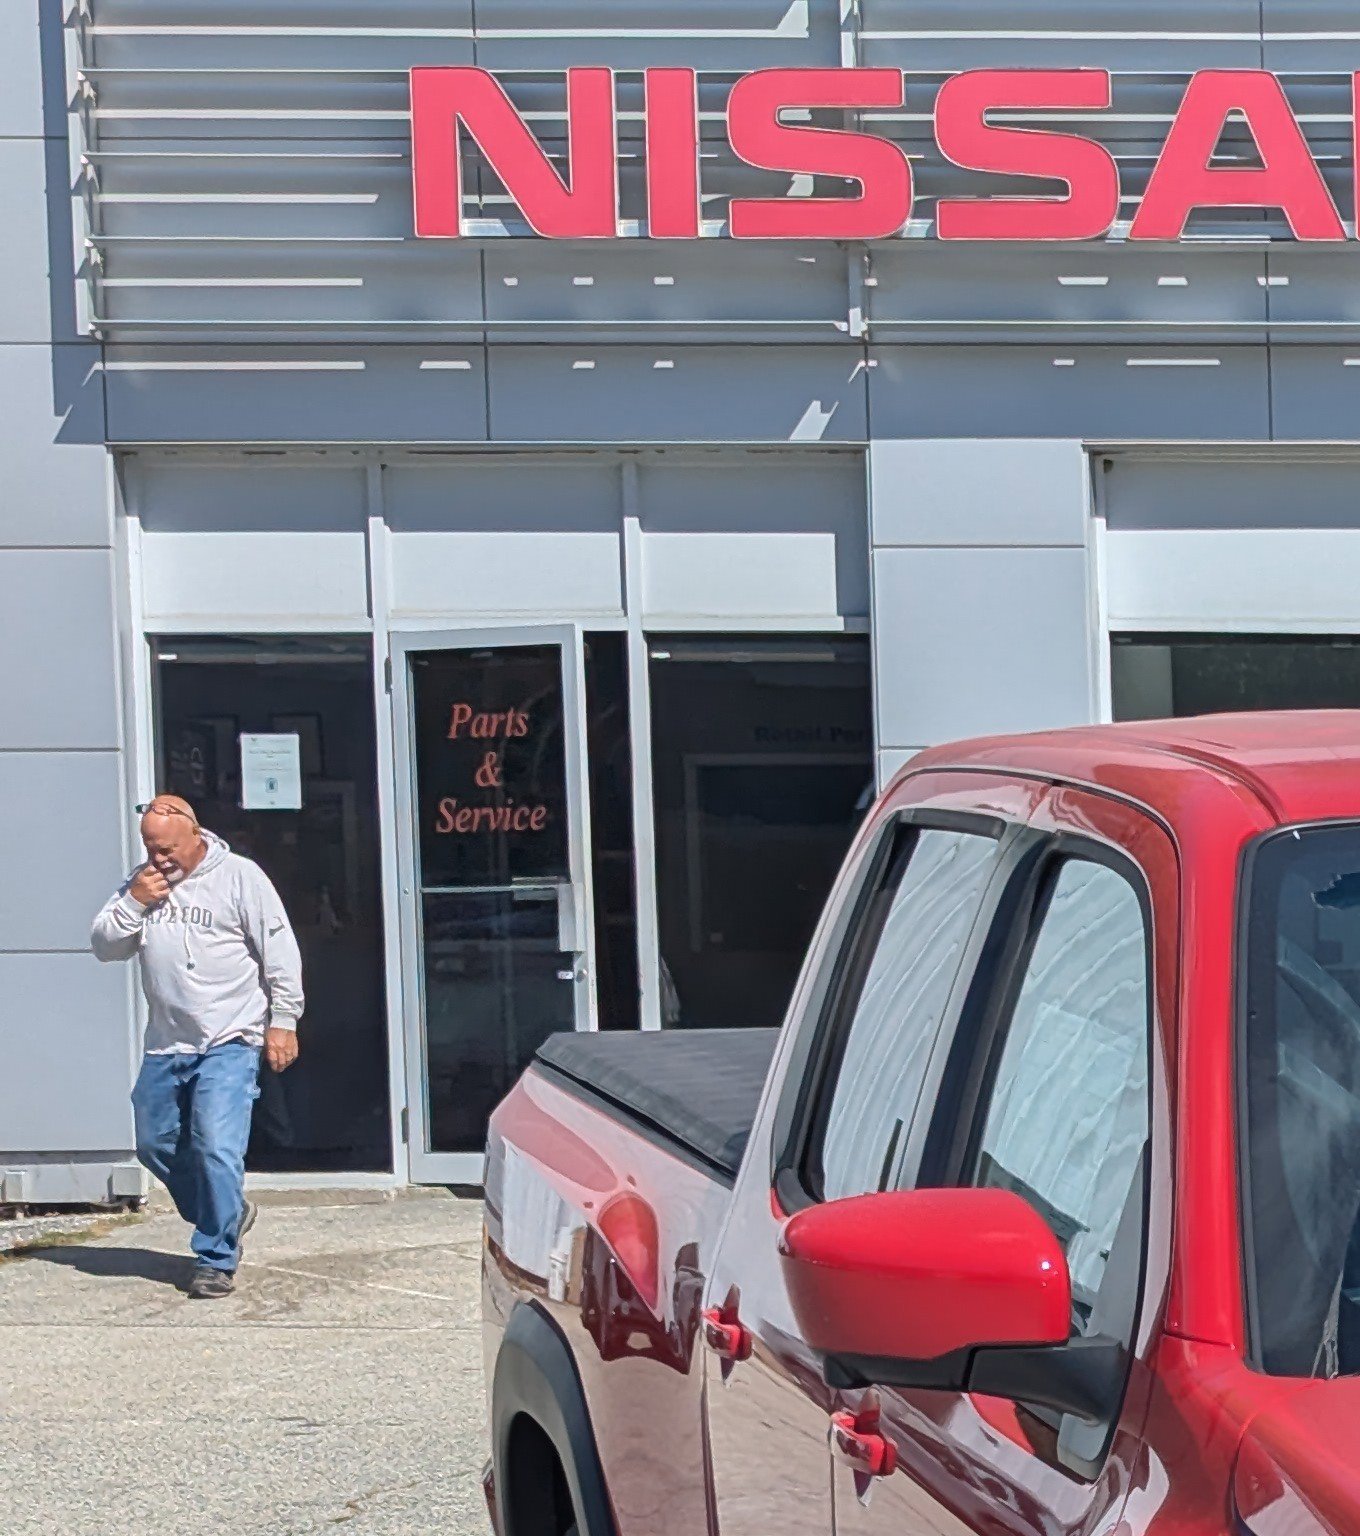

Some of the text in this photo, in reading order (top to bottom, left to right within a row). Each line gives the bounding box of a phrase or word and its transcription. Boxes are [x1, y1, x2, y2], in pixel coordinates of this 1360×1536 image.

[447, 702, 529, 739] Parts
[474, 751, 502, 787] &
[435, 797, 547, 833] Service
